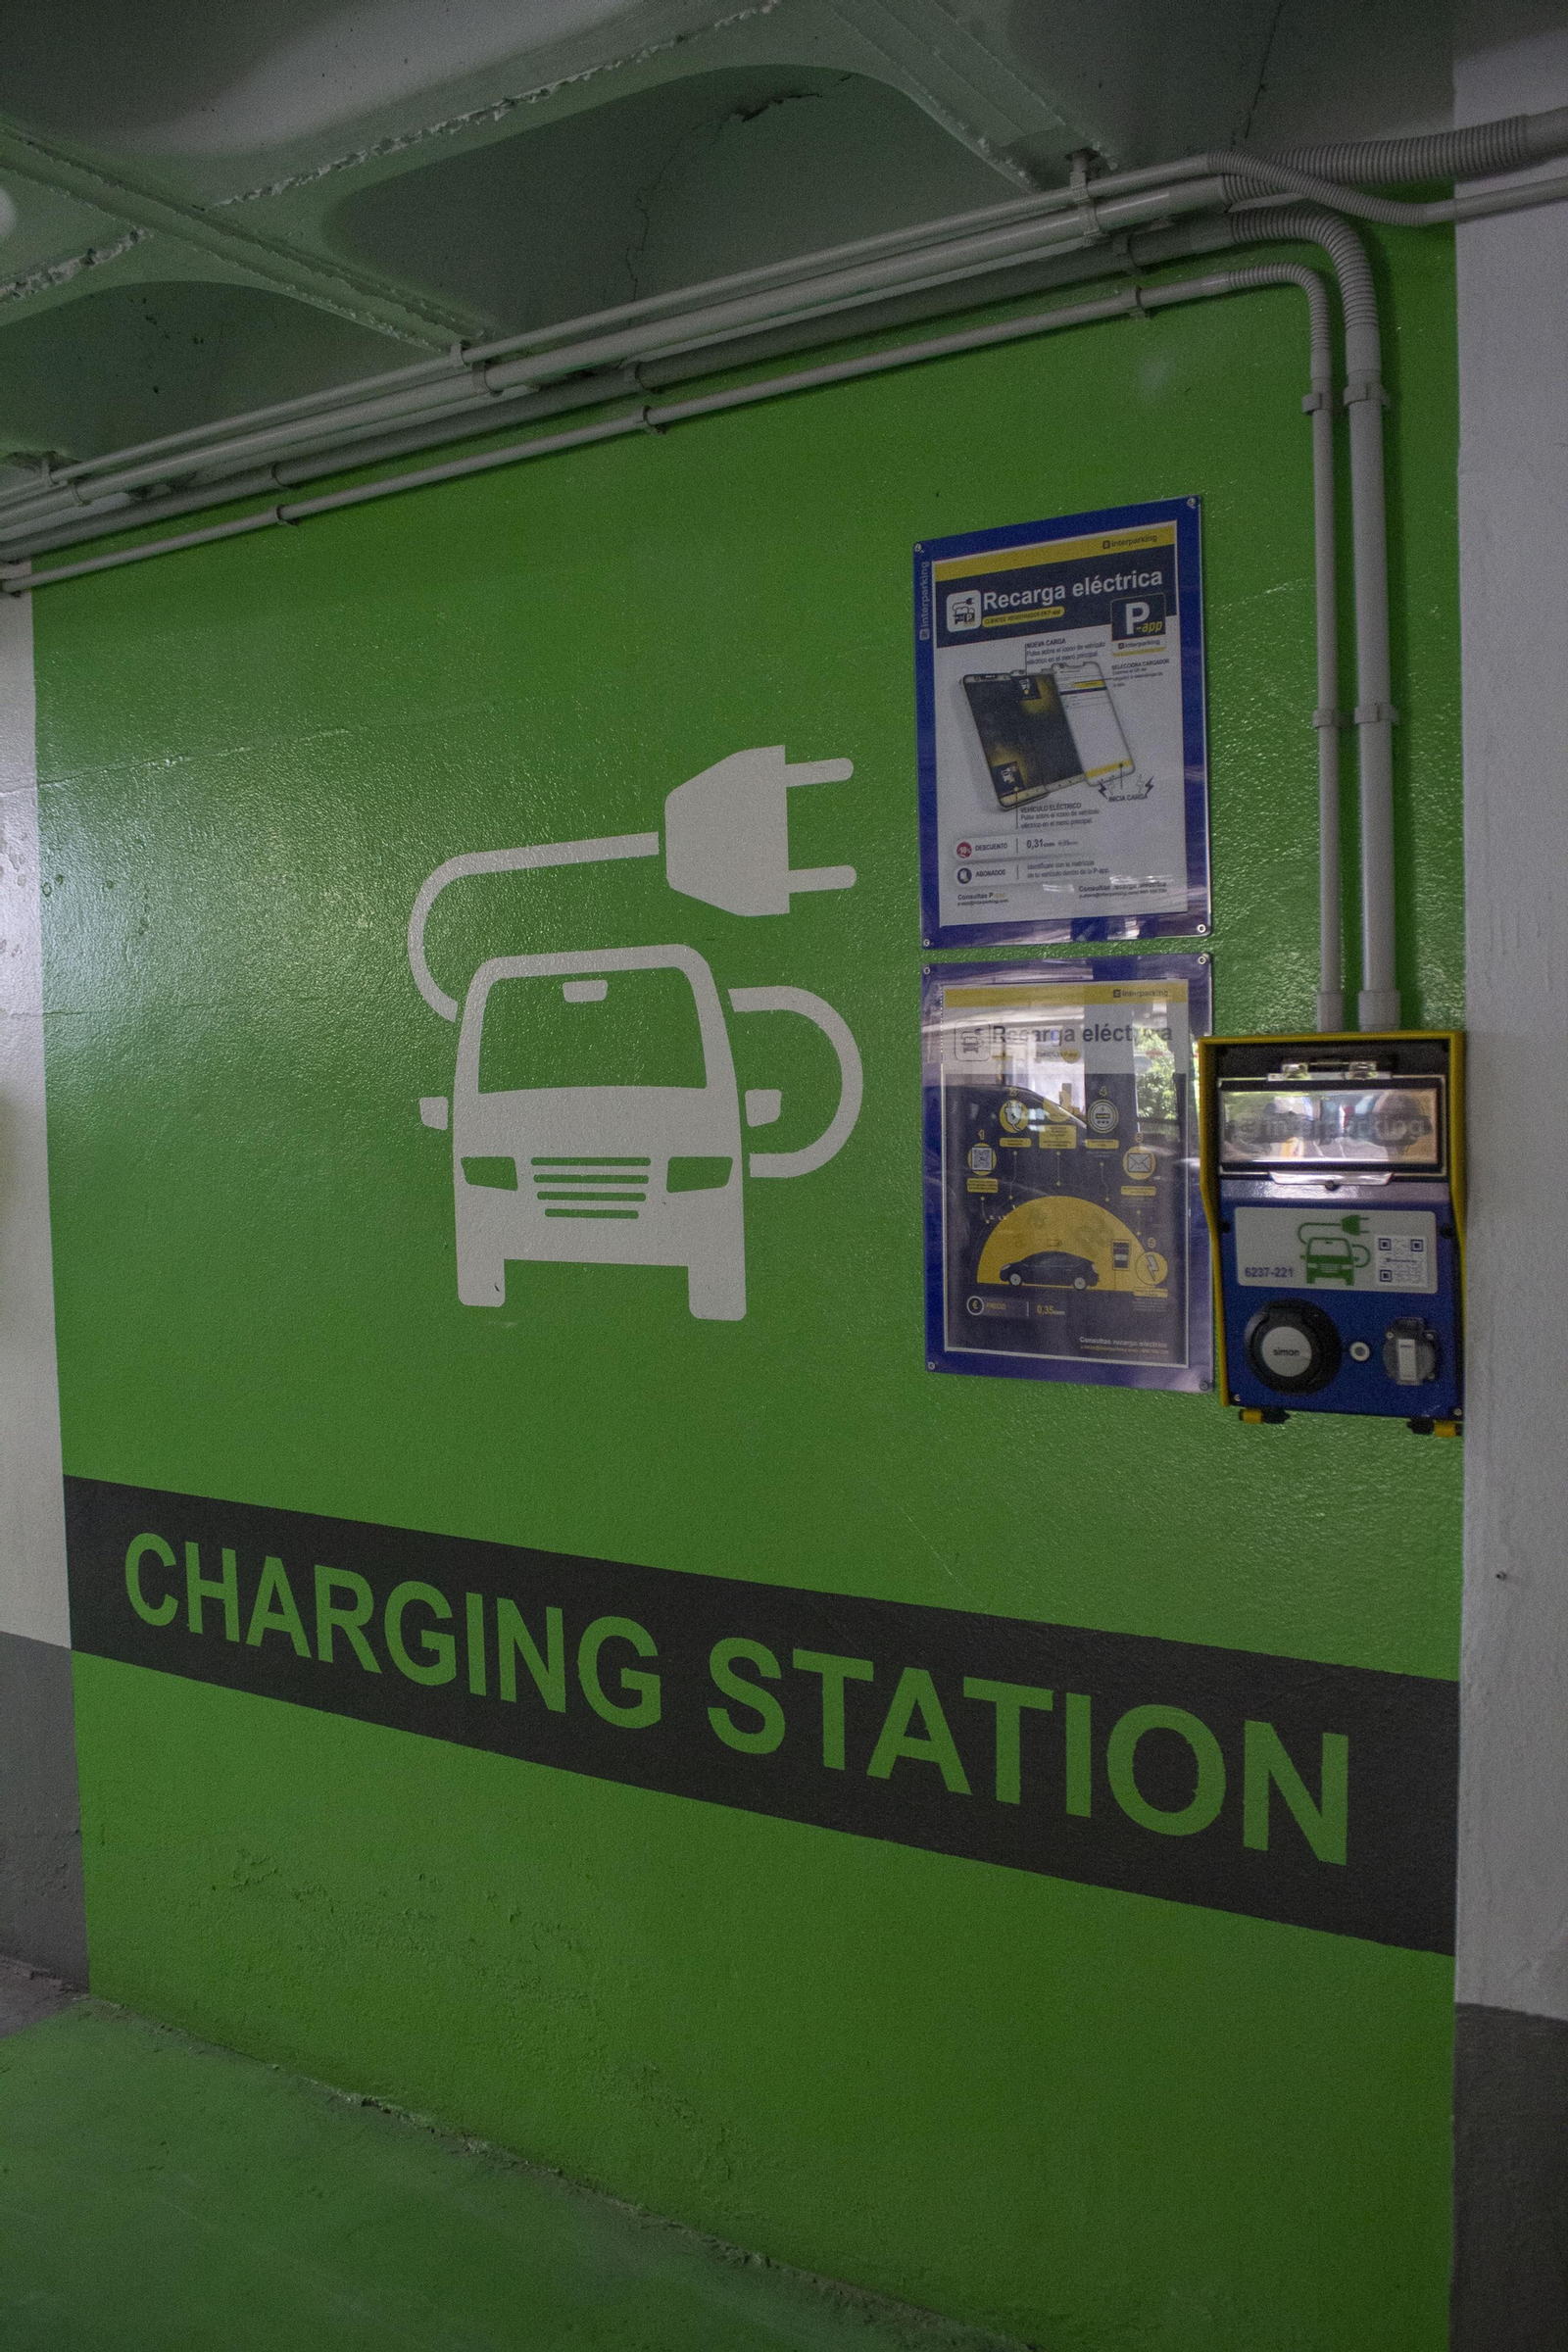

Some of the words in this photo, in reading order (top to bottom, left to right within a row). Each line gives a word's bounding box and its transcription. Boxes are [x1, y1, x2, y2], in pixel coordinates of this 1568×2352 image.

[983, 585, 1066, 611] Recarga
[1072, 570, 1163, 597] eléctrica
[1050, 802, 1081, 811] ELÉCTRICO
[975, 842, 1008, 851] DESCUENTO
[976, 868, 1006, 877] ABONADOS
[1082, 1022, 1172, 1043] eléctca
[1099, 1086, 1107, 1097] 4
[1245, 1267, 1294, 1277] 6237-221
[1079, 1336, 1110, 1345] Consultas
[1273, 1348, 1299, 1356] simon
[124, 1532, 662, 1729] CHARGING
[707, 1638, 1349, 1866] STATION
